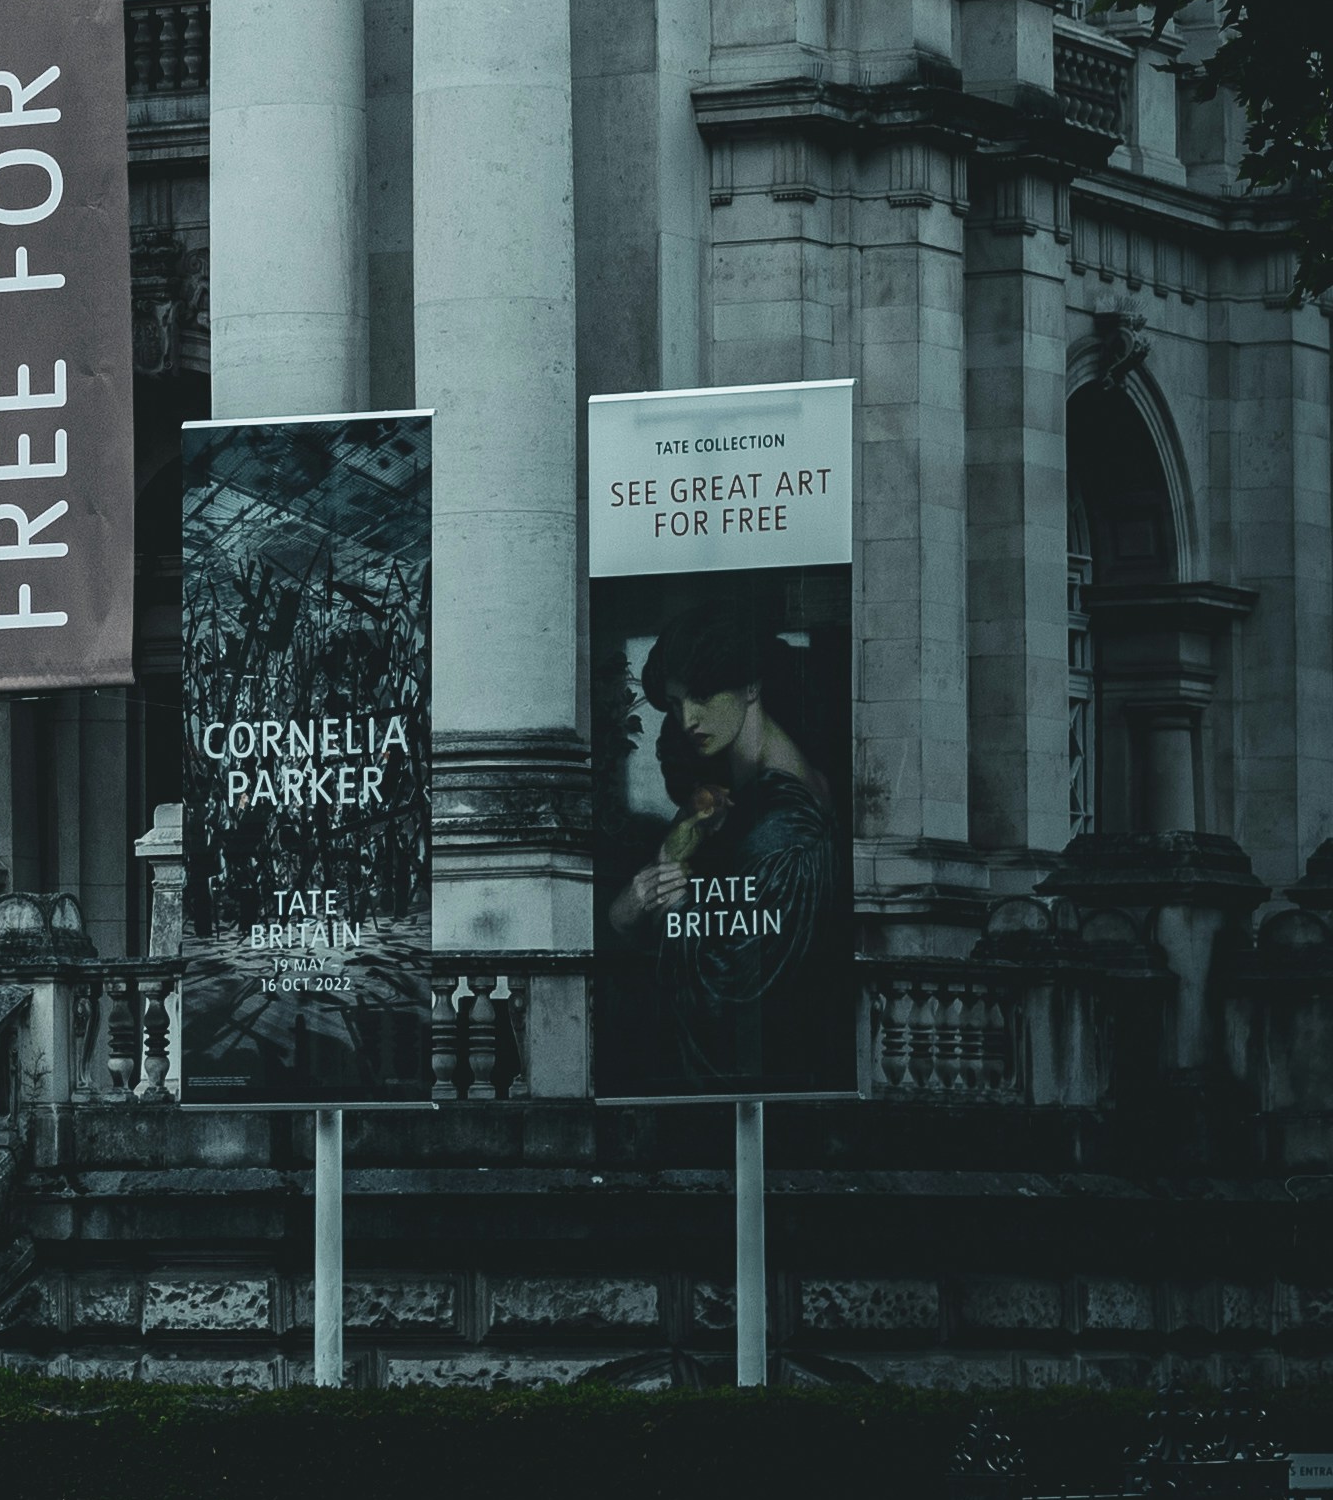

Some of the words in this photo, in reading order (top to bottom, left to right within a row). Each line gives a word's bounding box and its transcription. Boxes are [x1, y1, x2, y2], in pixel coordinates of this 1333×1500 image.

[655, 440, 689, 455] TATE
[694, 434, 785, 453] COLLECTION
[611, 480, 657, 507] SEE
[670, 473, 762, 503] GREAT
[775, 469, 832, 497] ART
[655, 510, 708, 538] FOR
[722, 505, 788, 534] FREE
[202, 716, 409, 760] CORNELIA
[227, 766, 383, 808] PARKER
[273, 889, 338, 916] TATE
[689, 876, 756, 903] TATE
[250, 921, 361, 949] BRITAIN
[666, 908, 781, 938] BRITAIN
[273, 958, 289, 972] 19
[293, 957, 326, 972] MAY
[261, 978, 277, 992] 16
[281, 977, 310, 992] OCT
[315, 976, 351, 992] 2022
